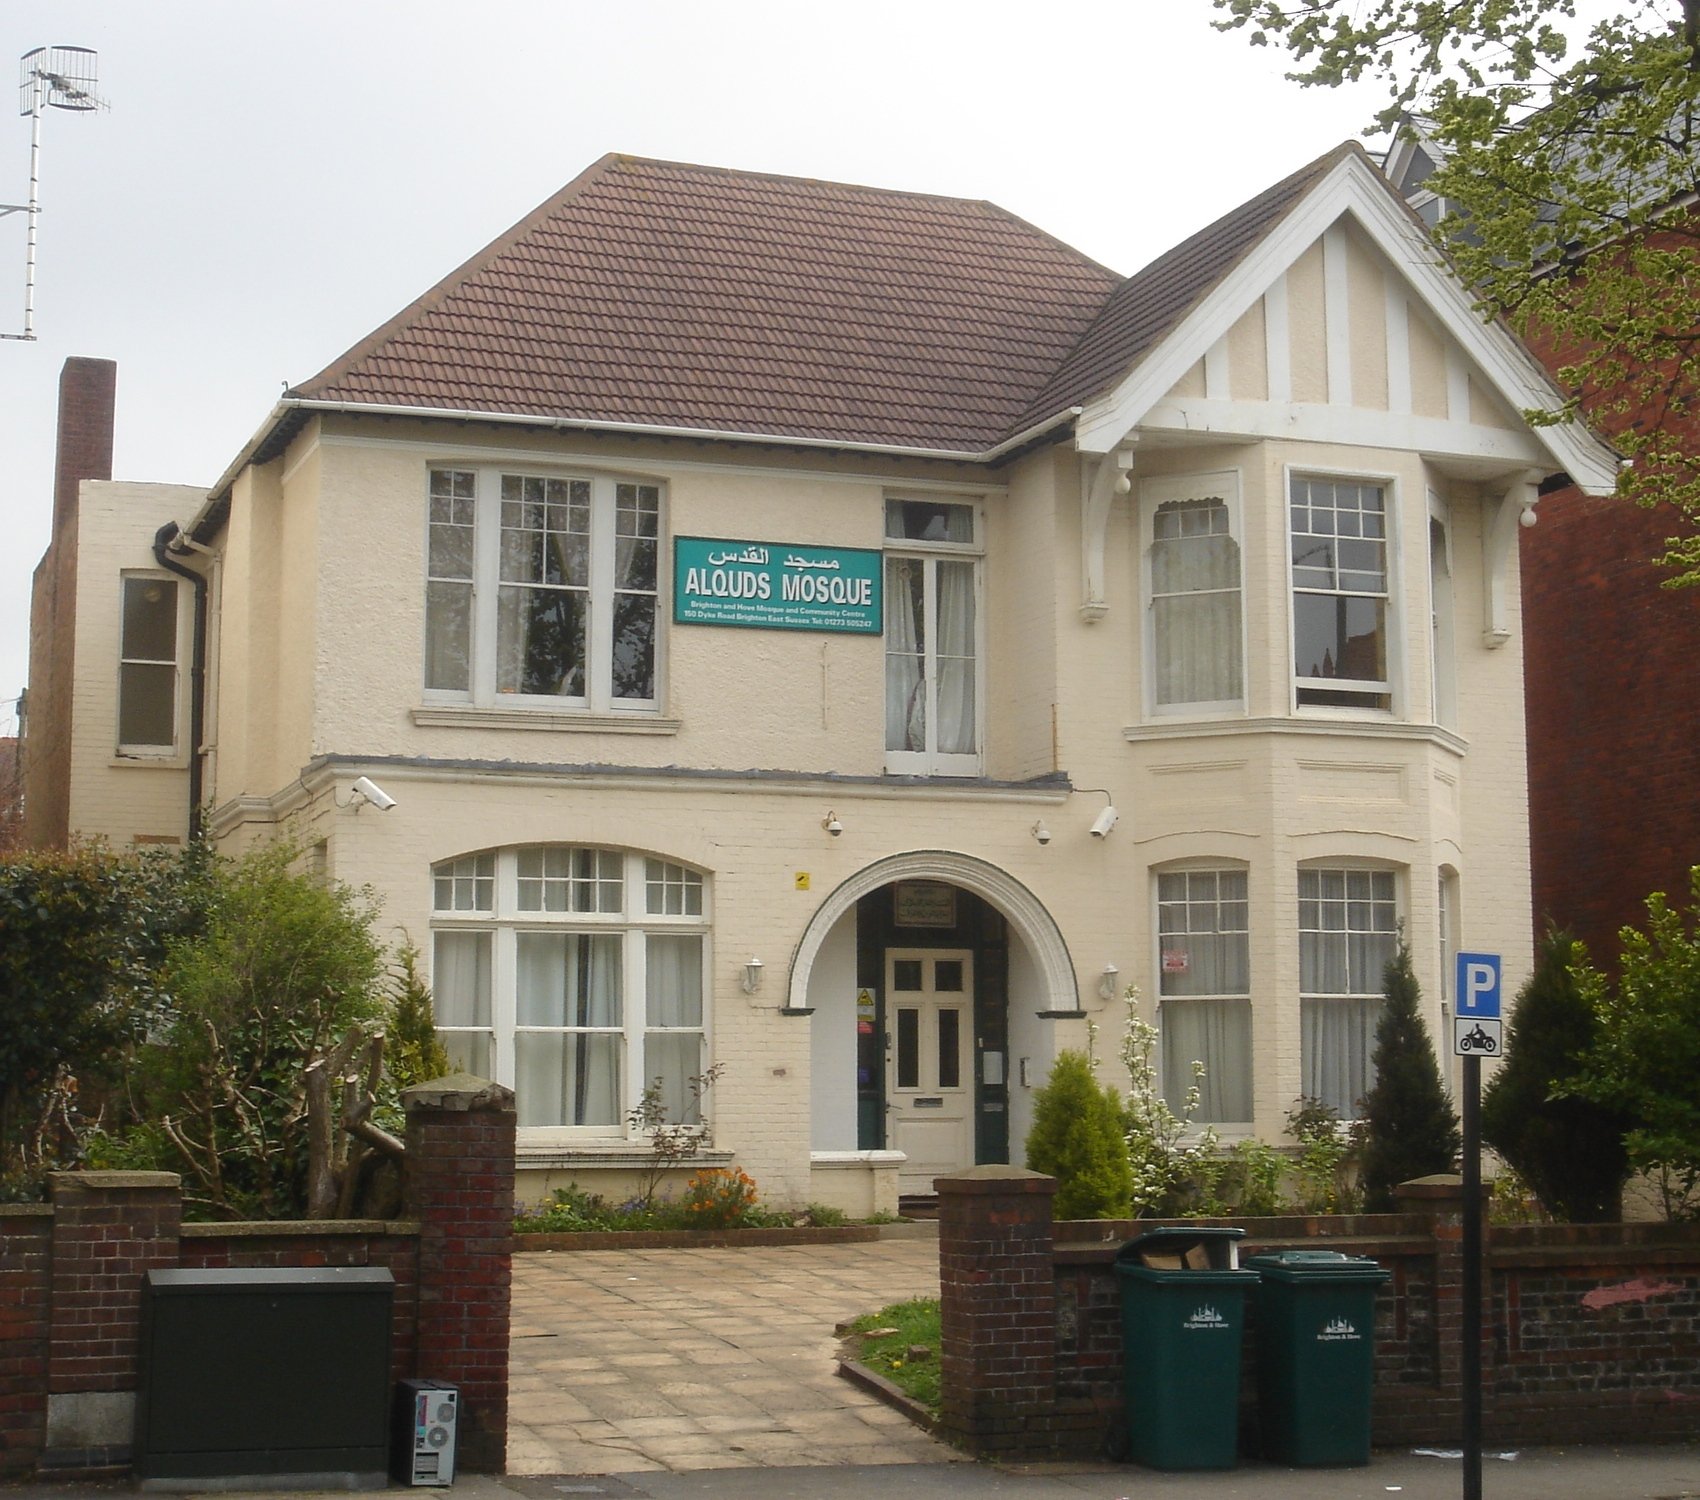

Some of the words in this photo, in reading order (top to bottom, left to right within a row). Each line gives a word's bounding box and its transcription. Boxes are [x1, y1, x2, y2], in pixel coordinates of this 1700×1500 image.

[708, 546, 769, 566] القدس
[783, 554, 840, 572] مسجد
[685, 567, 771, 600] ALQUDS
[782, 573, 872, 606] MOSQUE
[691, 600, 722, 609] Brighton
[756, 605, 784, 613] Mosque
[800, 608, 840, 617] Community
[717, 612, 735, 620] Road
[736, 613, 767, 622] Brighton
[768, 615, 784, 623] East
[785, 616, 809, 624] Sussex
[824, 618, 845, 626] 01273
[1467, 963, 1495, 1007] P
